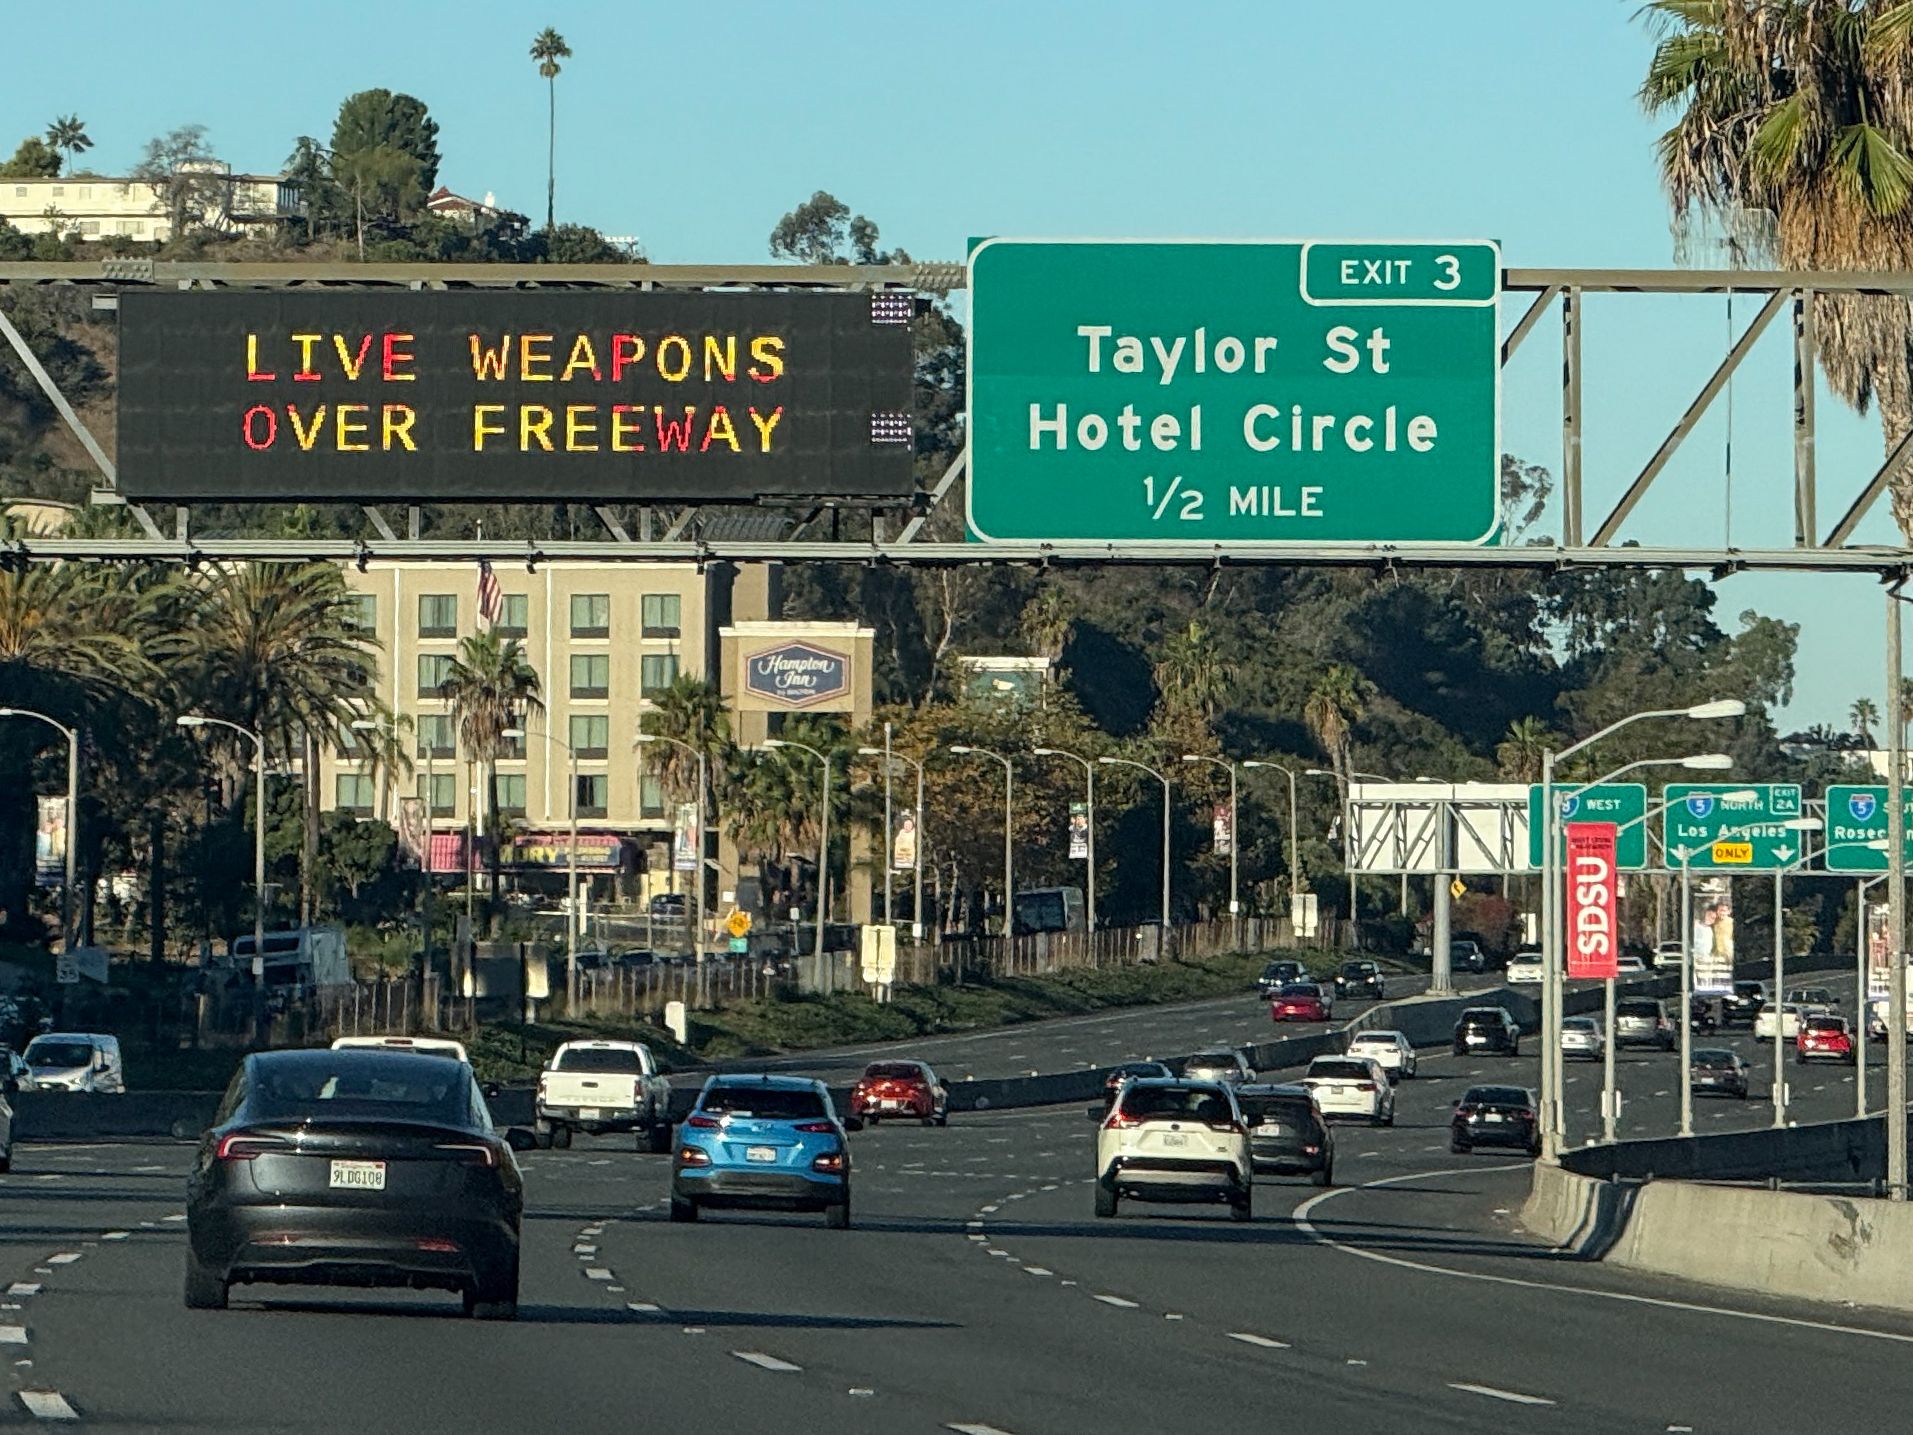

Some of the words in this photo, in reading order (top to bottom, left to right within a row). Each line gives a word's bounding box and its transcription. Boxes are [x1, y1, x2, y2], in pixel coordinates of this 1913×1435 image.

[1341, 260, 1412, 285] EXIT
[1433, 255, 1461, 291] 3
[247, 334, 417, 382] LIVE
[468, 334, 786, 382] WEAPONS
[1077, 325, 1278, 385] Taylor
[1322, 325, 1391, 375] St
[243, 404, 418, 451] OVER
[474, 404, 784, 453] FREEWAY
[1028, 403, 1202, 452] Hotel
[1242, 403, 1438, 453] Circle
[1143, 475, 1204, 521] 1/2
[1229, 485, 1324, 518] MILE
[757, 655, 835, 675] Hampton
[775, 671, 817, 688] Inn
[1774, 788, 1796, 798] EXIT
[1586, 798, 1622, 811] WEST
[1695, 799, 1705, 813] 5
[1720, 799, 1764, 811] NORTH
[1776, 799, 1795, 810] 2A
[1857, 801, 1867, 815] 5
[1677, 823, 1708, 838] Los
[1718, 823, 1787, 842] Angeles
[1715, 848, 1749, 859] ONLY
[1575, 856, 1610, 956] SDSU
